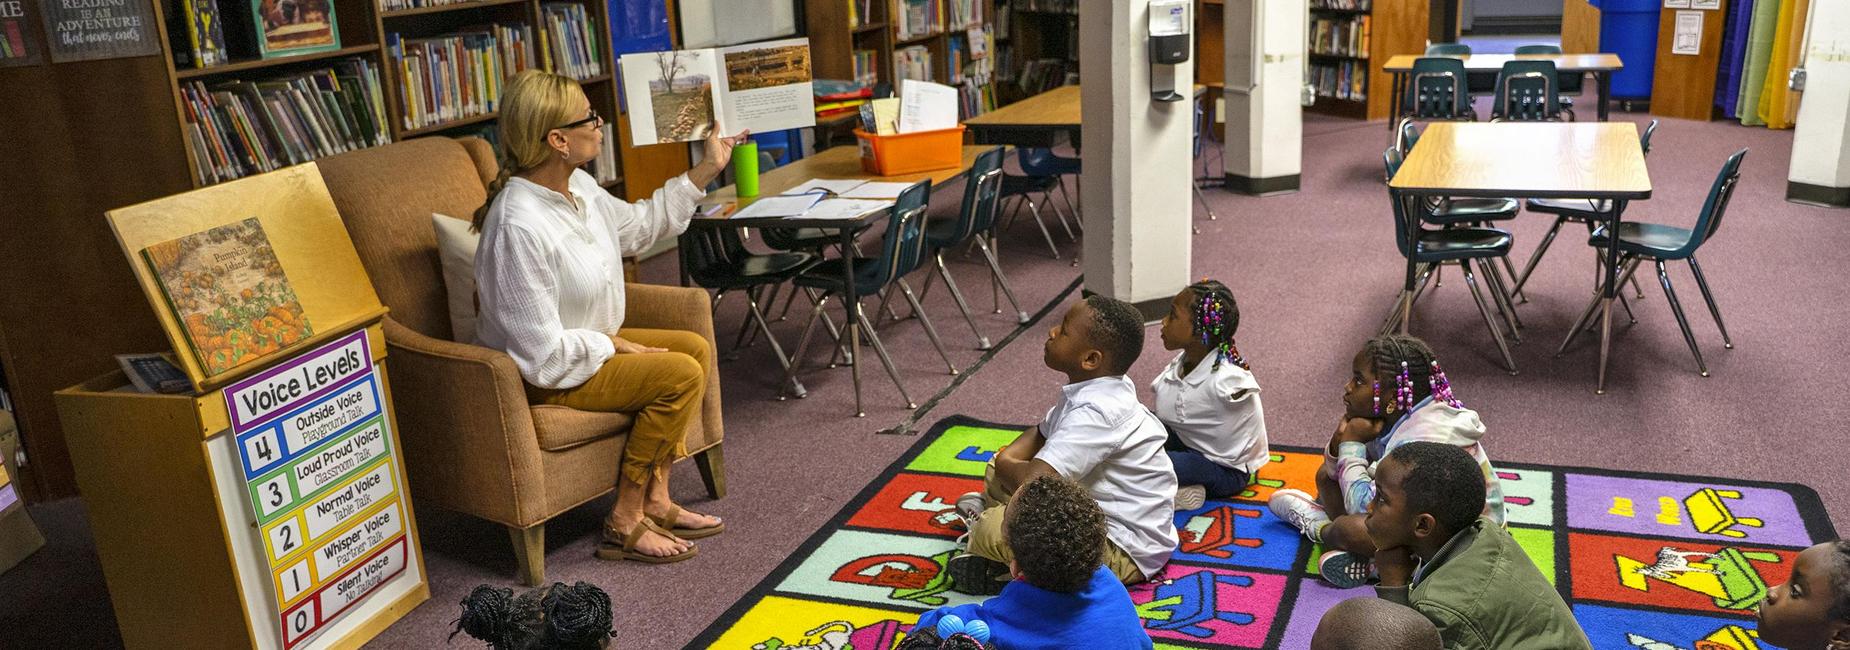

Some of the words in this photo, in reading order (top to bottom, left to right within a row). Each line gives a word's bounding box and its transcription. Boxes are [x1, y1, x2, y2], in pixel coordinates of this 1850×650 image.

[62, 0, 126, 9] READING
[80, 9, 93, 19] IS
[95, 8, 112, 19] AN
[57, 16, 140, 31] ADVENTURE
[62, 31, 84, 45] that
[86, 32, 112, 42] never
[114, 28, 140, 42] ends
[213, 247, 248, 263] Pumpkin
[225, 258, 248, 272] Island
[242, 378, 302, 416] Voice
[303, 348, 360, 391] Levels
[296, 404, 335, 431] Outside
[336, 390, 363, 410] Voice
[302, 413, 347, 444] Playground
[346, 405, 364, 421] Talk
[255, 436, 272, 461] 4
[297, 457, 322, 480] Loud
[323, 442, 353, 466] Proud
[354, 428, 380, 448] Voice
[314, 460, 355, 486] Classroom
[354, 448, 372, 464] Talk
[268, 481, 283, 507] 3
[316, 486, 354, 518] Normal
[354, 473, 381, 494] Voice
[333, 502, 355, 523] Table
[353, 494, 372, 510] Talk
[280, 525, 295, 552] 2
[323, 530, 362, 560] Whisper
[364, 513, 391, 534] Voice
[336, 542, 367, 568] Partner
[366, 531, 384, 546] Talk
[292, 569, 300, 592] 1
[337, 571, 362, 596] Silent
[364, 555, 389, 578] Voice
[345, 590, 356, 603] No
[295, 610, 307, 633] 0
